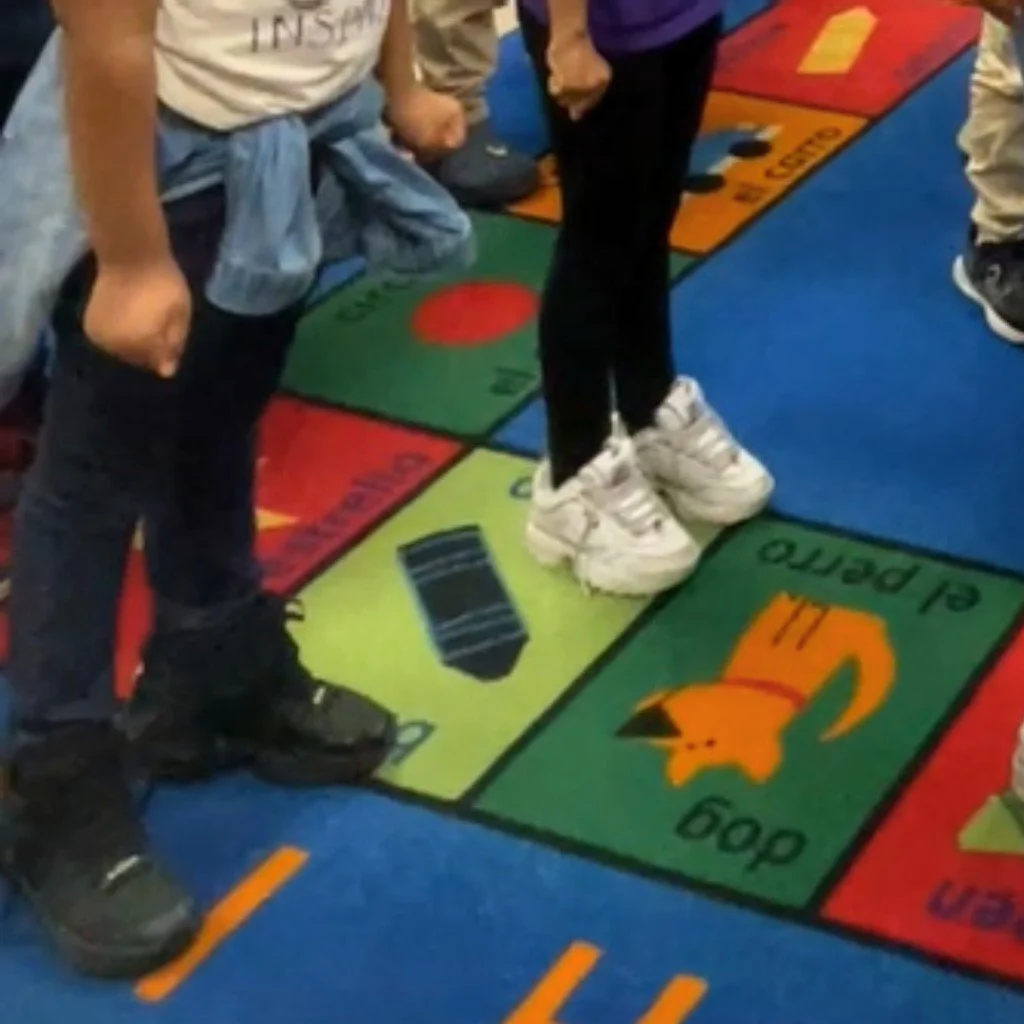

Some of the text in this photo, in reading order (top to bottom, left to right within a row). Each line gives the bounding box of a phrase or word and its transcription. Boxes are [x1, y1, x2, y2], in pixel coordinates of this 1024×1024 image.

[757, 537, 982, 616] el perro
[674, 795, 810, 873] dog
